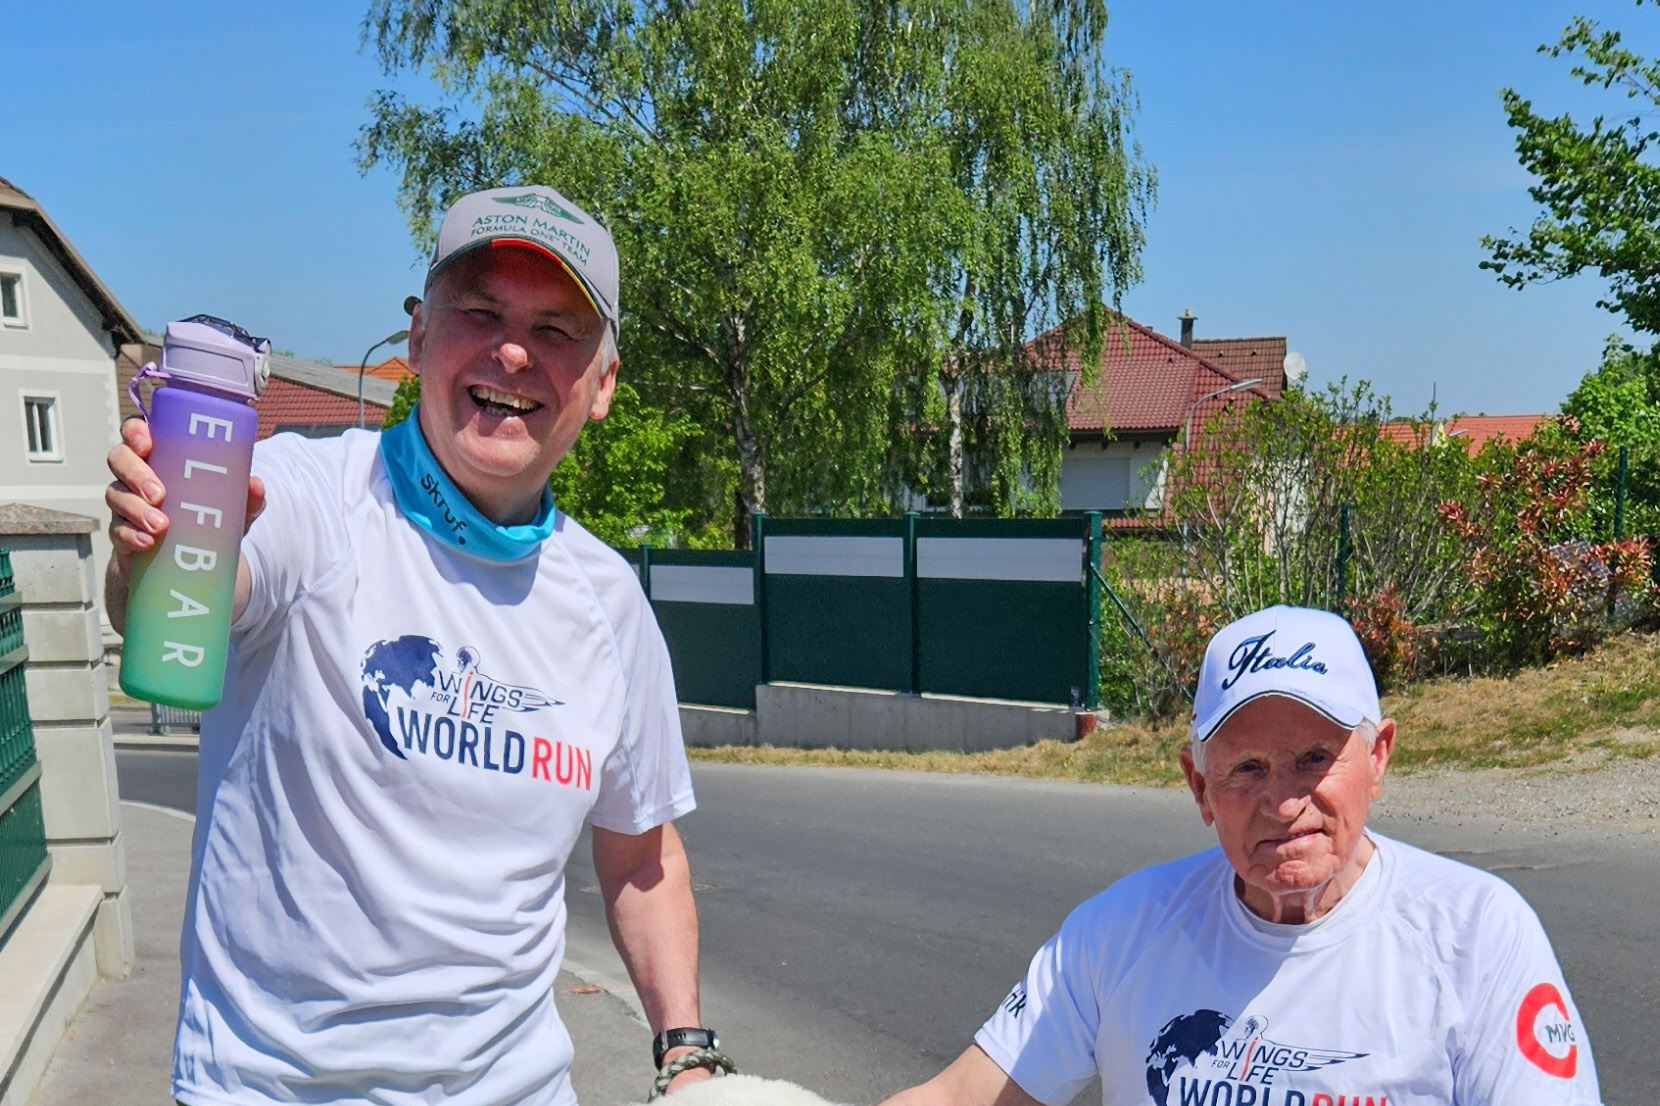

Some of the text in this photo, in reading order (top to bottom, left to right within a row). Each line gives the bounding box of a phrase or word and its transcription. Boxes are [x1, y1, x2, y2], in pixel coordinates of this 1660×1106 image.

[470, 224, 588, 267] FORMULA ONE TEAM
[472, 214, 591, 258] ASTON MARTIN
[1221, 629, 1328, 691] Italia
[431, 691, 500, 724] FOR LIFE
[439, 671, 523, 708] WINGS
[397, 706, 593, 791] WORLD RUN
[1211, 1059, 1279, 1085] FOR LIFE
[1221, 1037, 1308, 1069] WINGS
